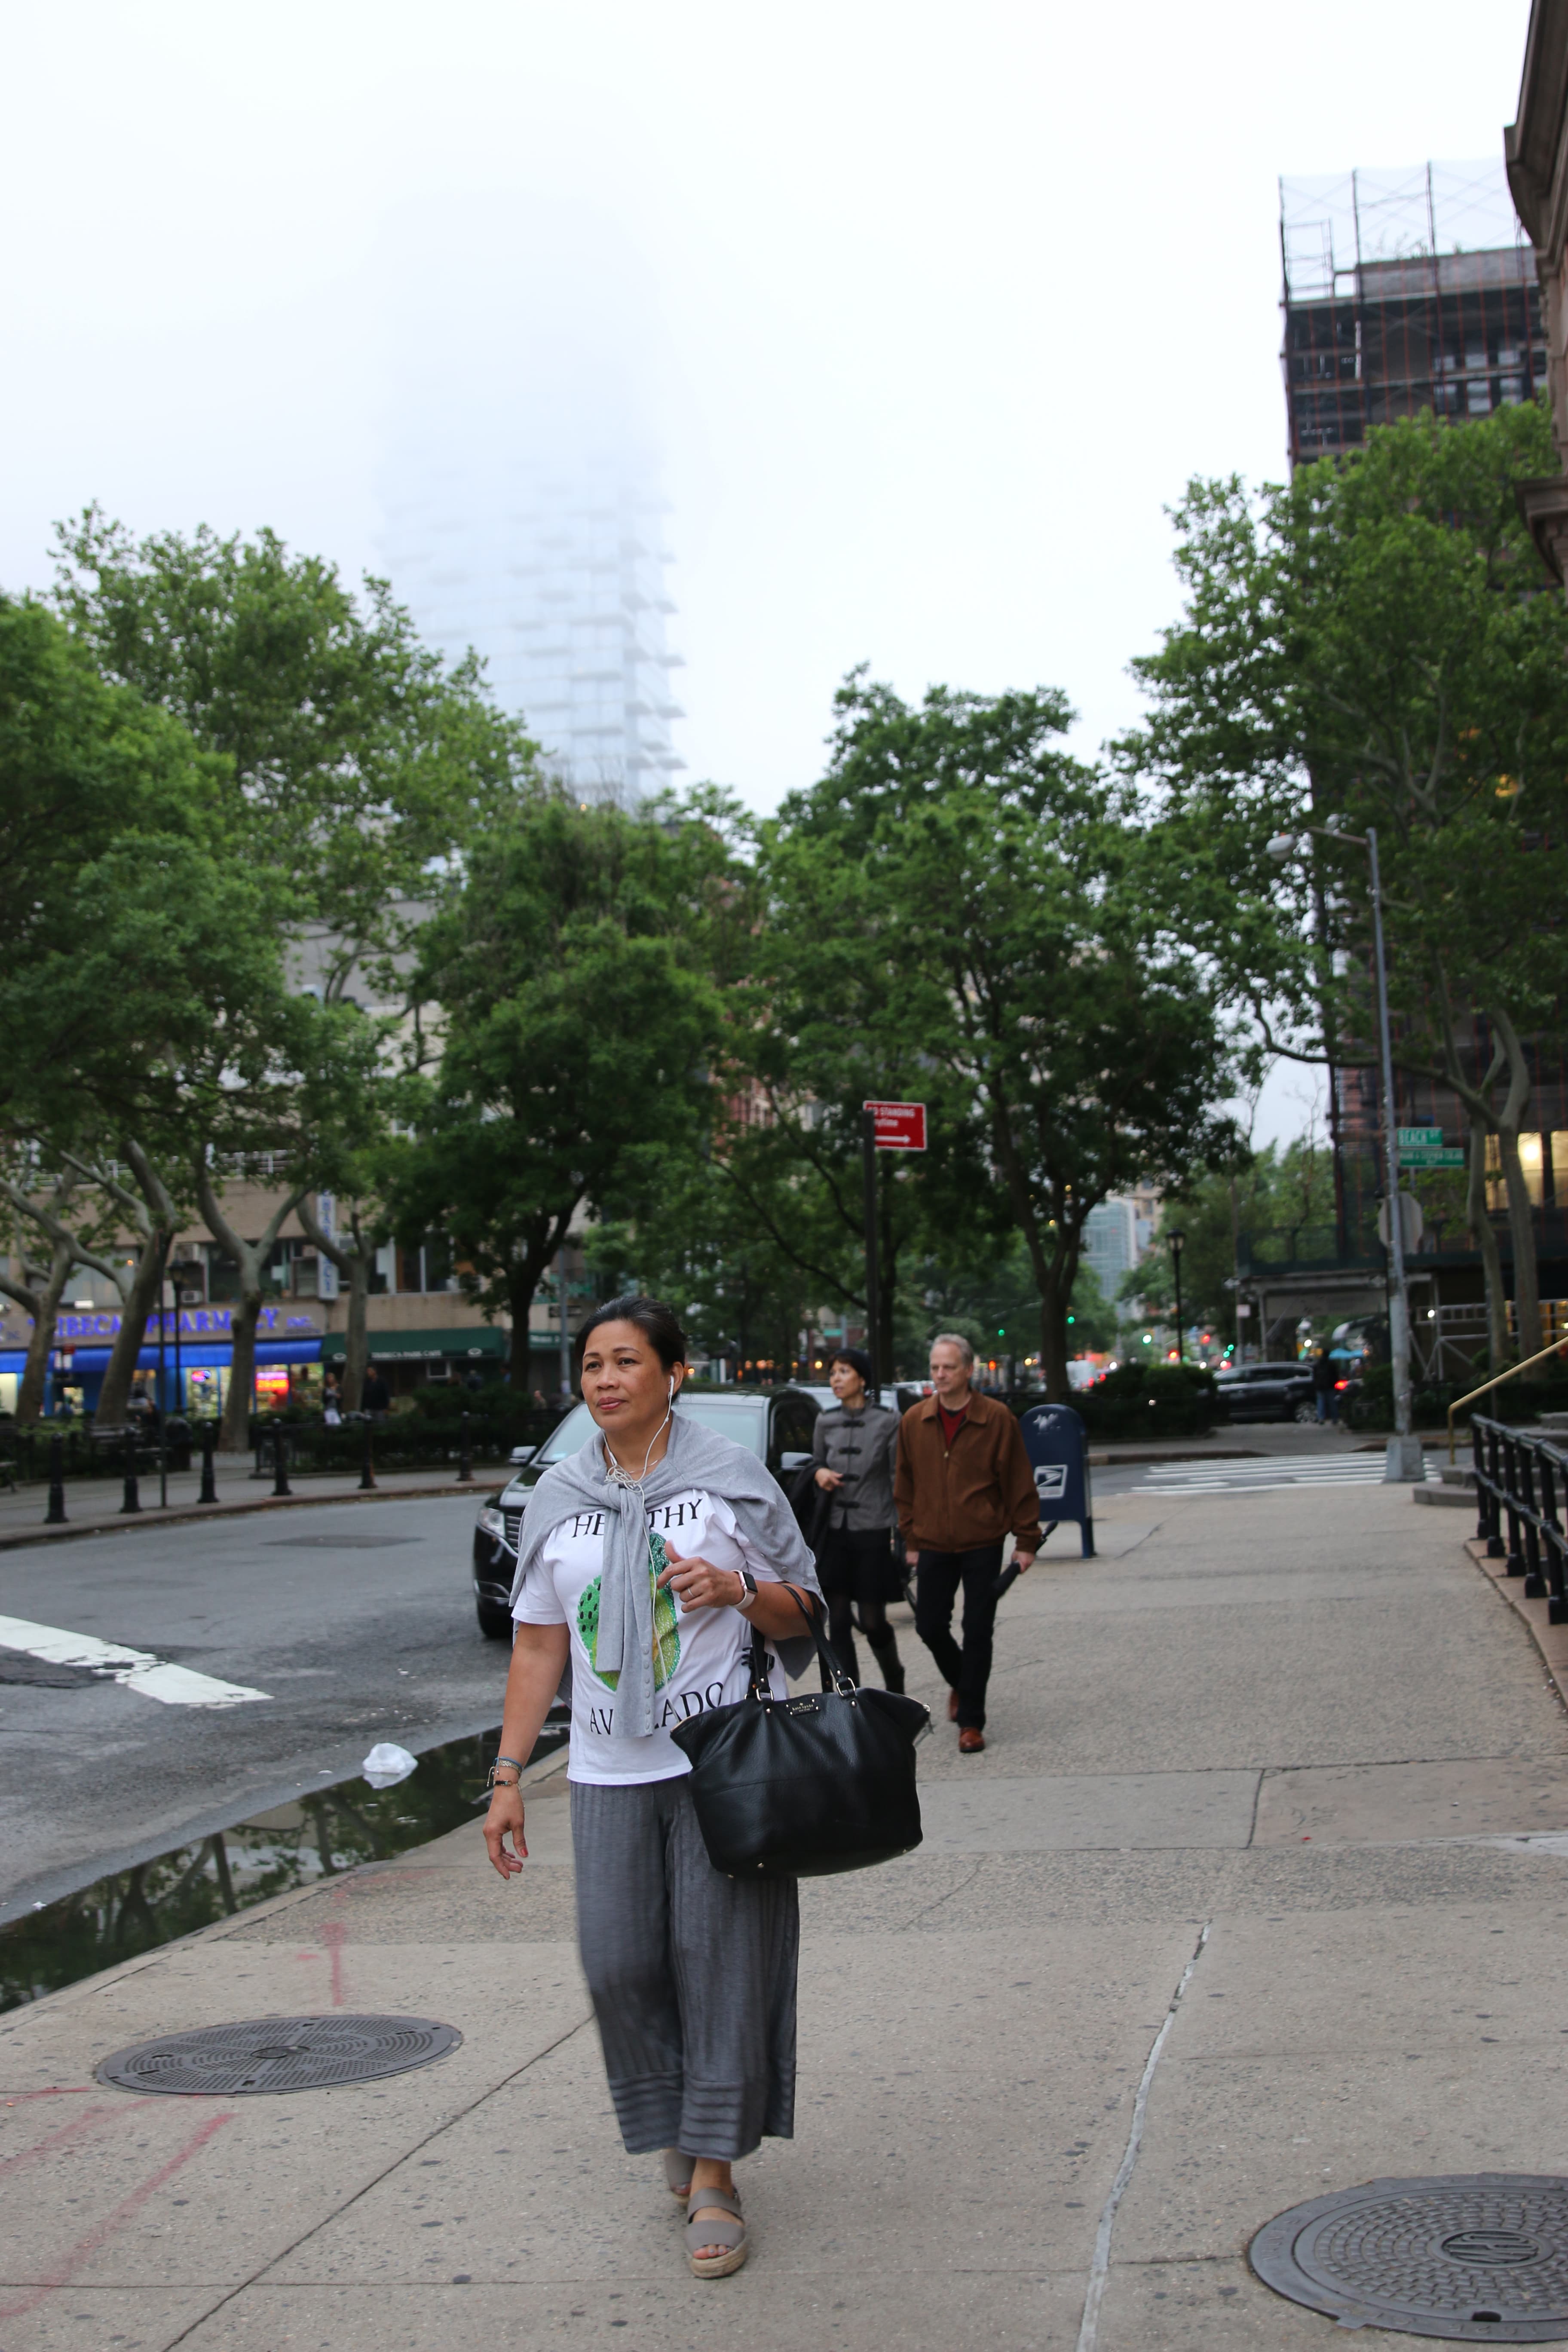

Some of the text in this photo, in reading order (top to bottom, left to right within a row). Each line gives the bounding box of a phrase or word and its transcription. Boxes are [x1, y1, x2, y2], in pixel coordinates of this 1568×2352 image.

[880, 1107, 915, 1118] STANDING
[1400, 1130, 1427, 1143] BEACH
[572, 1498, 703, 1537] HETHY
[590, 1682, 723, 1735] AVADO
